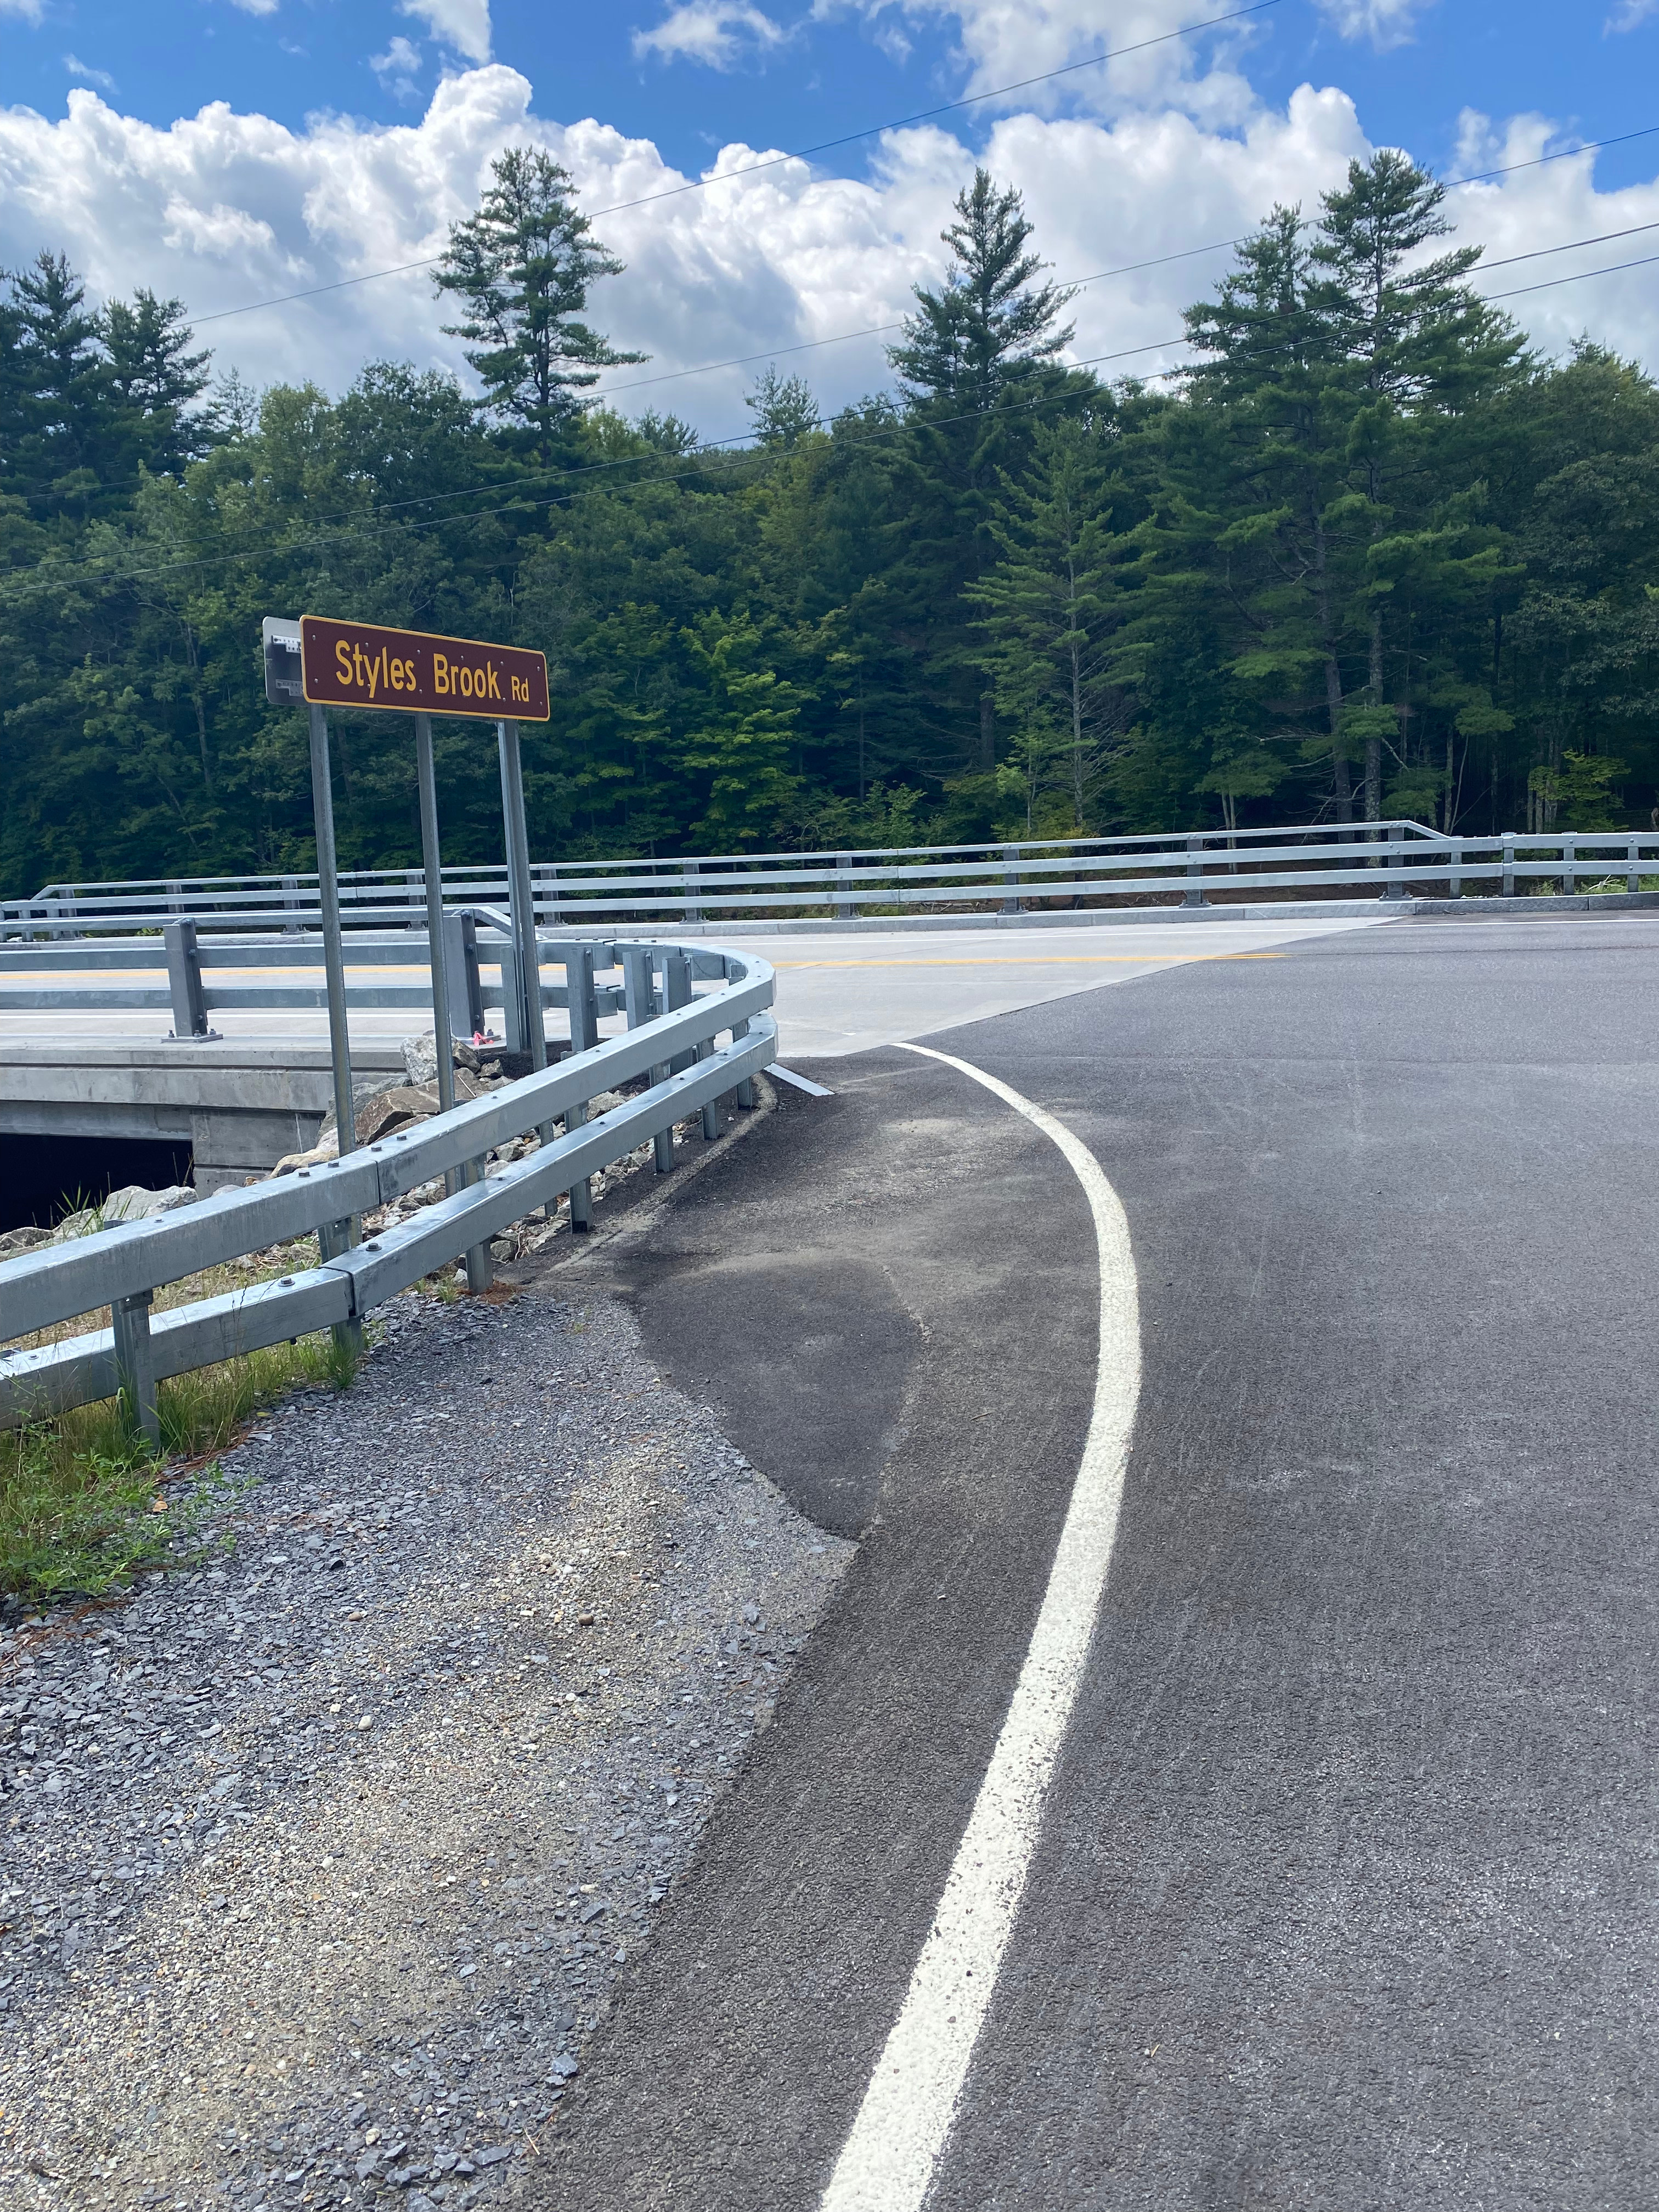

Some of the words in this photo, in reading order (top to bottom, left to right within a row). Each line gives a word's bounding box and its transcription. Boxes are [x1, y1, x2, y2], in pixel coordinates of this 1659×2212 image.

[335, 640, 416, 698] Styles
[433, 653, 501, 699] Brook
[511, 676, 529, 702] Rd
